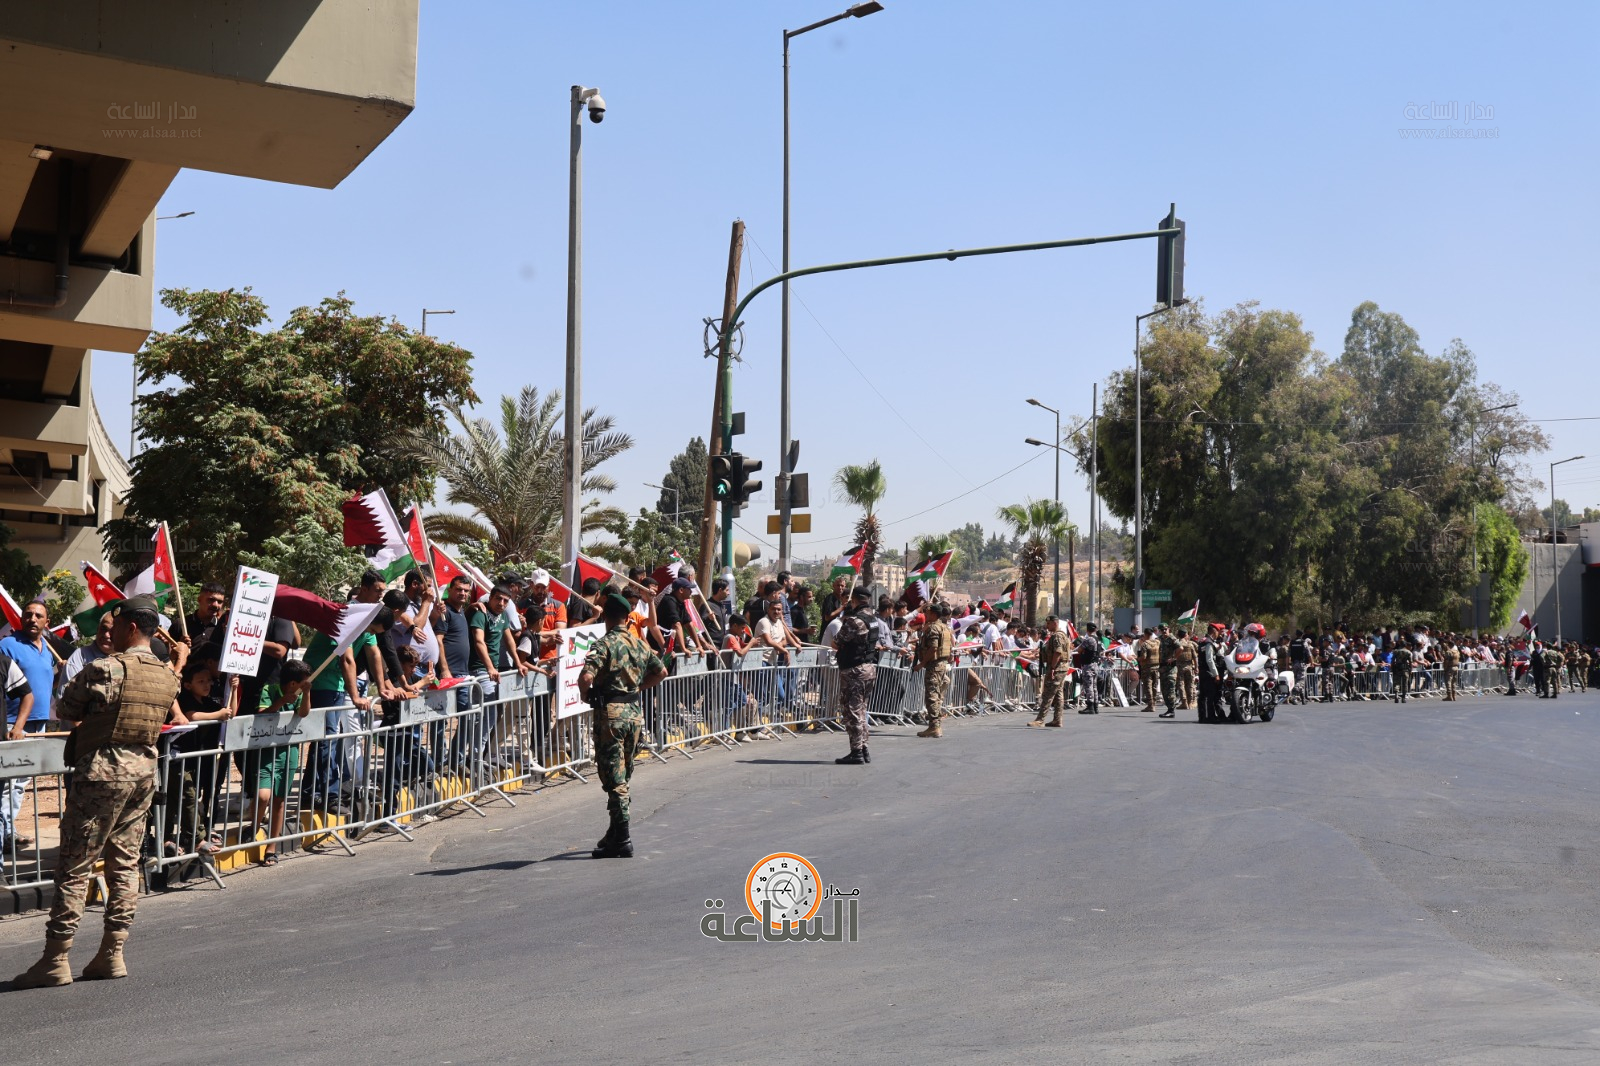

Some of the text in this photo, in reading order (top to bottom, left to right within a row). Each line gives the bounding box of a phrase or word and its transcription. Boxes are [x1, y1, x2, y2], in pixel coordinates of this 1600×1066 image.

[233, 620, 262, 641] بالشيخ
[229, 641, 259, 657] تميم
[246, 724, 304, 741] خدمات المدينة
[0, 755, 35, 769] خدما
